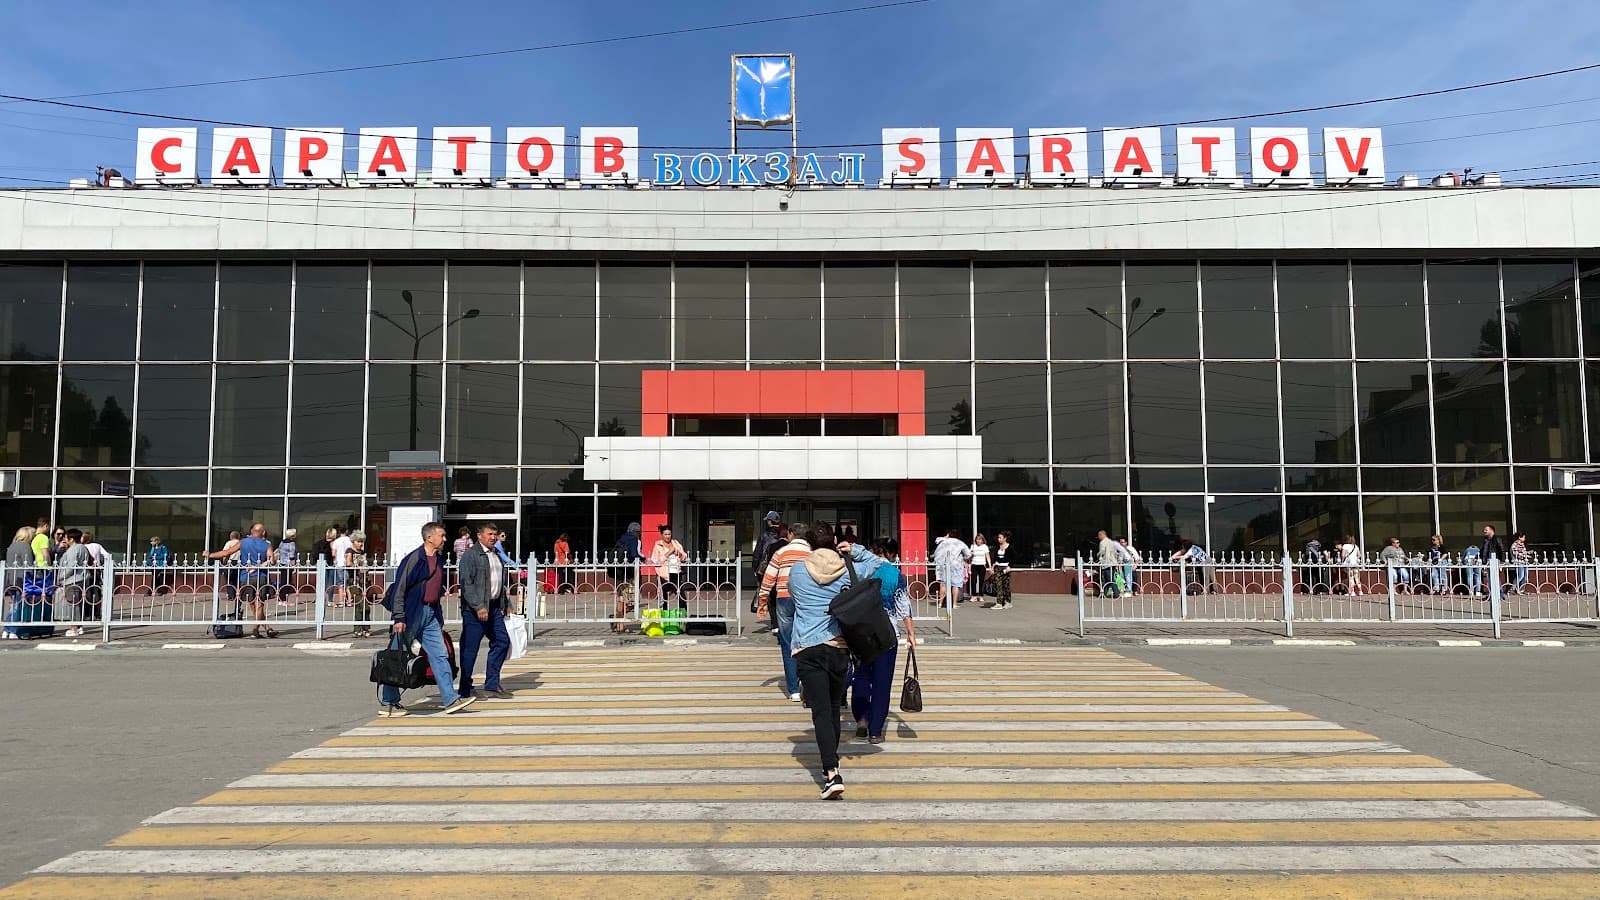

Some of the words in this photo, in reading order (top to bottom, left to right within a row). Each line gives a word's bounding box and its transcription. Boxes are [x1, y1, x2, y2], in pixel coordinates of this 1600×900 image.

[150, 137, 626, 174] САРАТОВ
[654, 152, 866, 186] ВОКЗАЛ
[898, 137, 1372, 174] SARATOV
